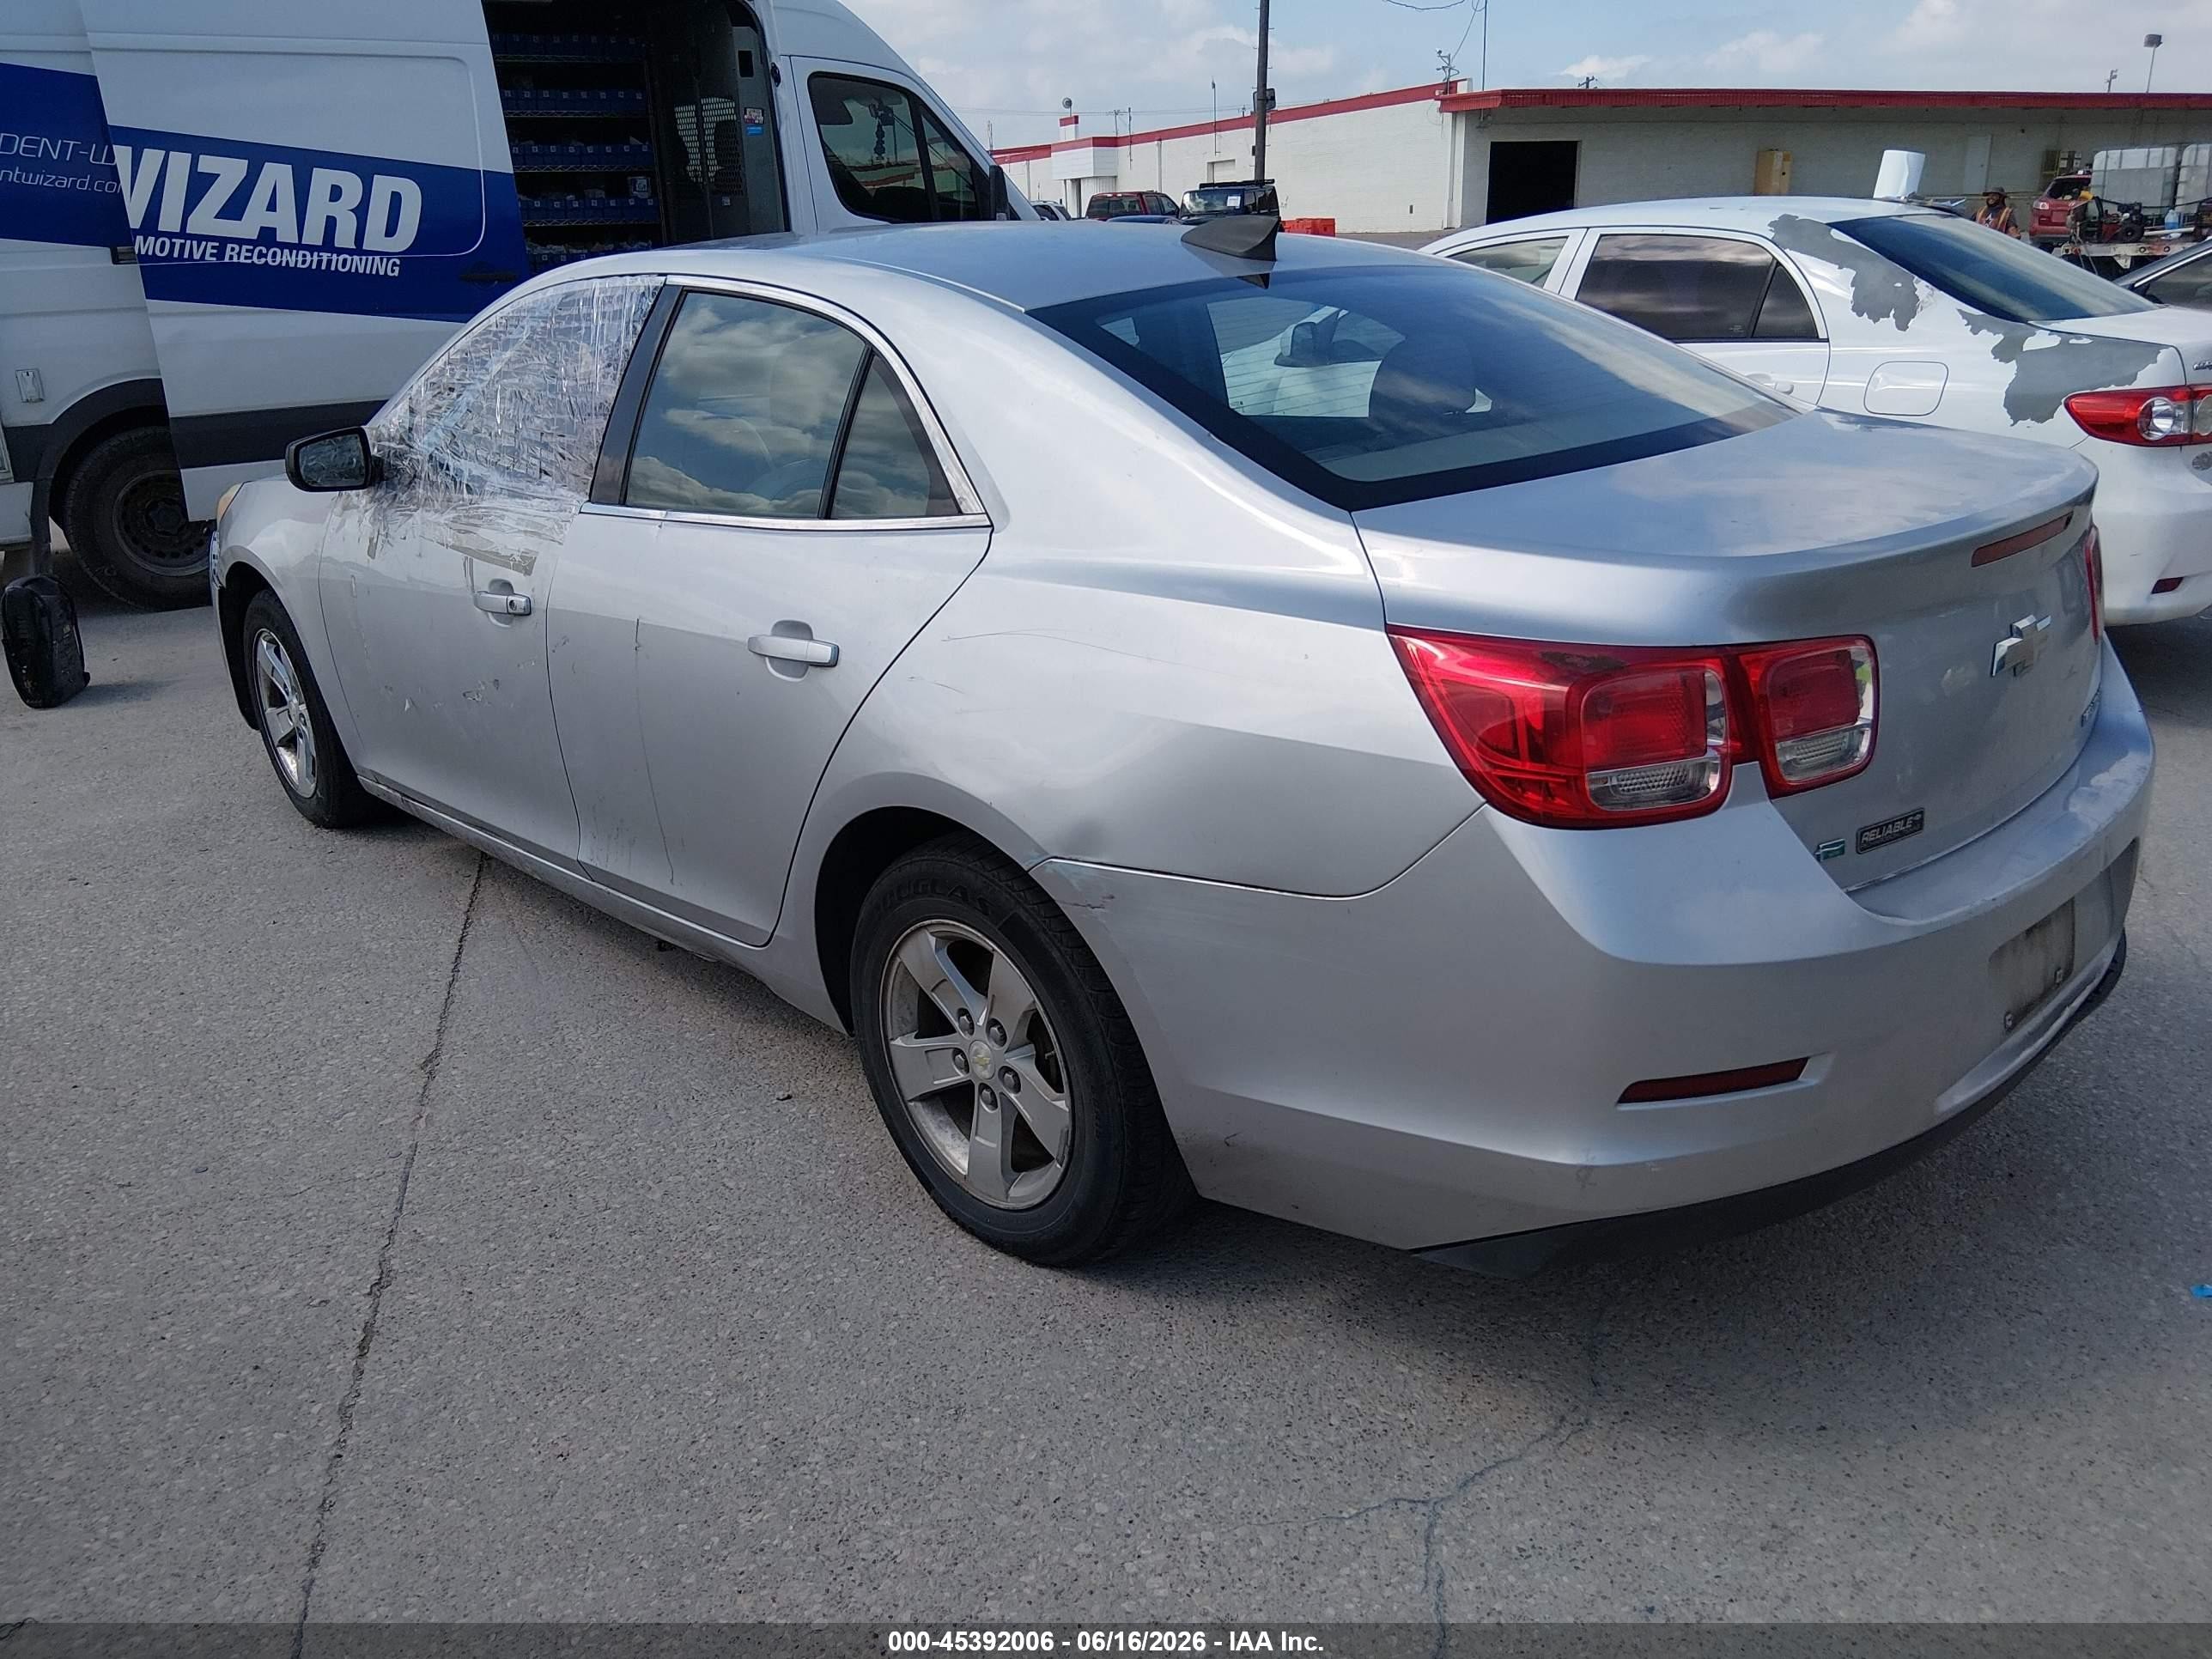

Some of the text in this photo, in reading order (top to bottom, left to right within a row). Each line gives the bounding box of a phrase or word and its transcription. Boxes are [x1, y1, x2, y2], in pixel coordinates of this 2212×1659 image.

[134, 235, 401, 276] MOTIVE RECONDITIONING
[1860, 817, 1914, 843] RELIABLE
[876, 878, 997, 919] OUGLAS
